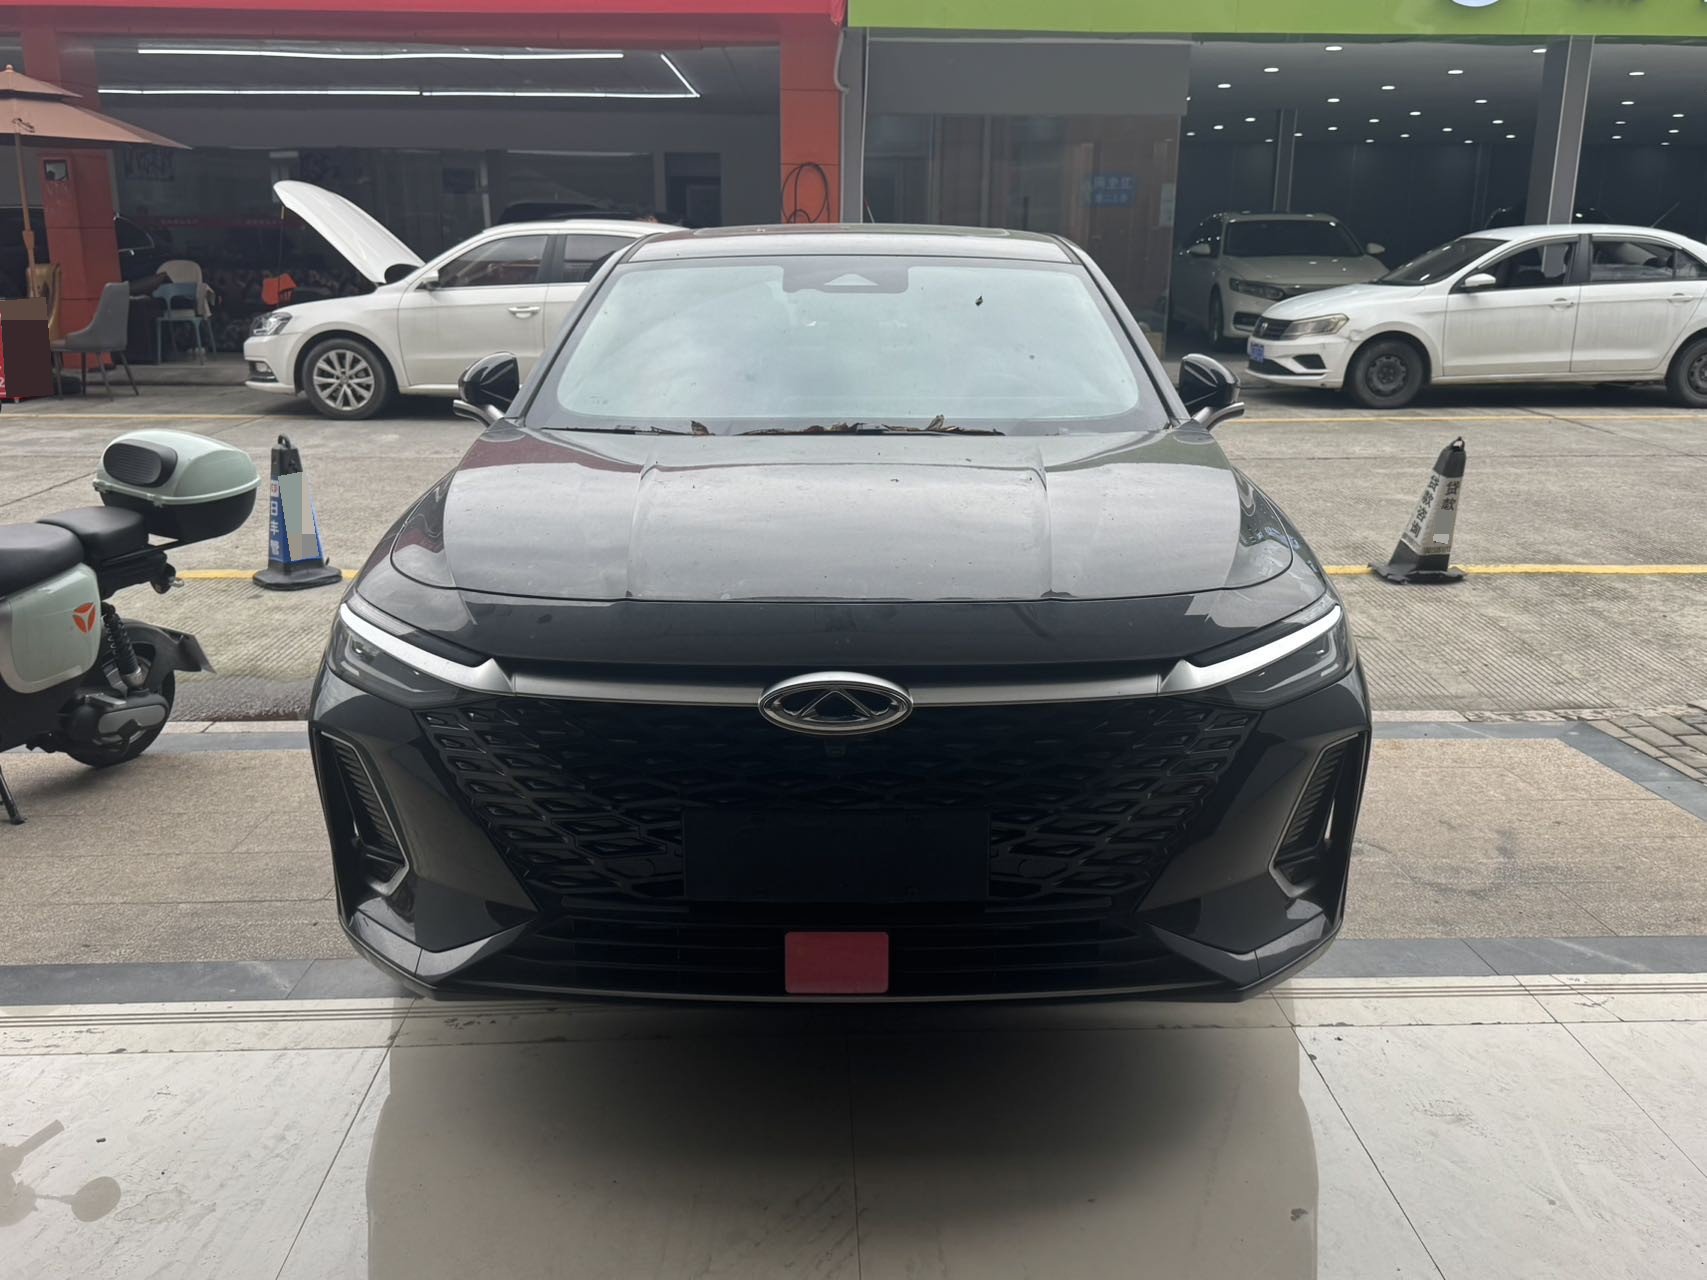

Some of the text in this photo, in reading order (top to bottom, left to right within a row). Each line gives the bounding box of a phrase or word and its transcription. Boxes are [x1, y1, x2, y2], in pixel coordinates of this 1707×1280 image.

[1410, 475, 1440, 538] 贷款咨询
[1441, 481, 1460, 511] 贷款
